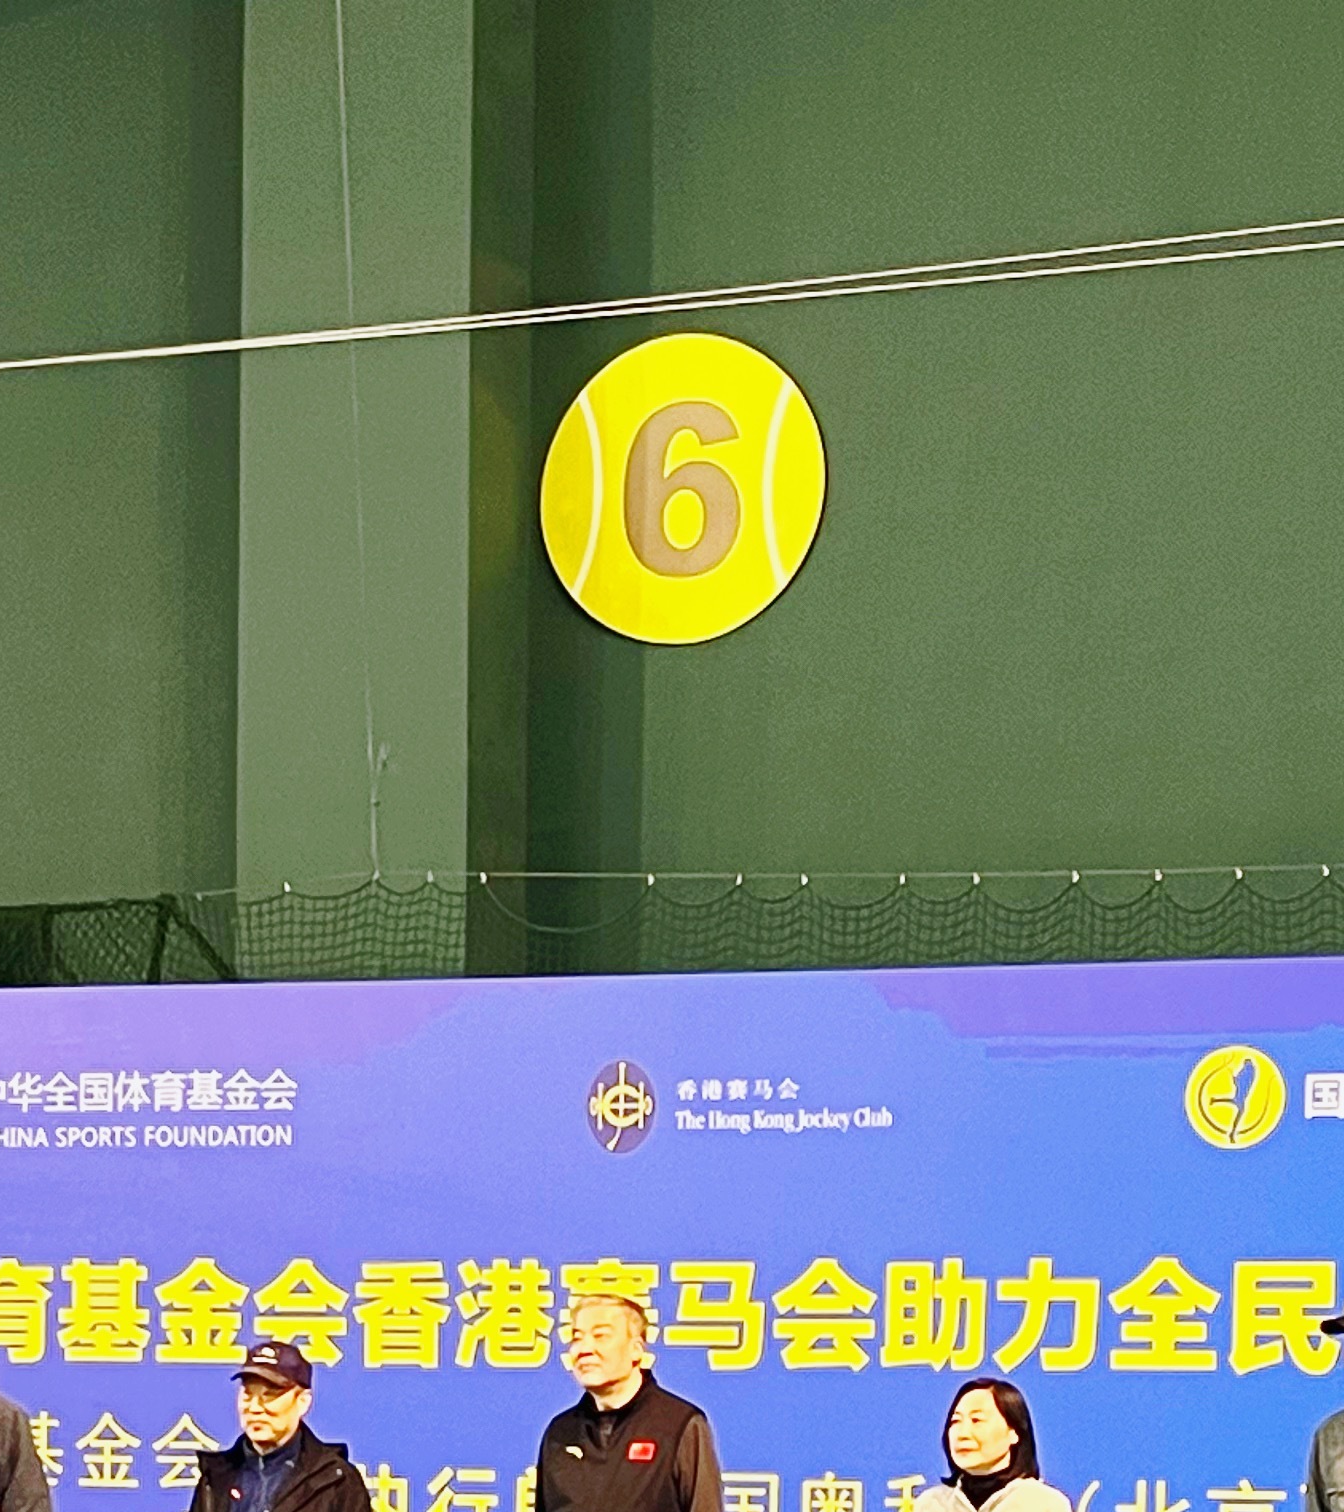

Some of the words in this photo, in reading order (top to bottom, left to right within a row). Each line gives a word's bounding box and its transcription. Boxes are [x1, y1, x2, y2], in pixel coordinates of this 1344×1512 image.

[623, 400, 741, 578] 6
[676, 1077, 800, 1101] 香港赛马会
[674, 1109, 706, 1130] The
[708, 1108, 752, 1135] Hong
[753, 1108, 797, 1133] Kong
[797, 1107, 852, 1134] Jockey
[853, 1105, 894, 1128] Club
[55, 1125, 138, 1149] SPORTS
[144, 1124, 293, 1148] FOUNDATION
